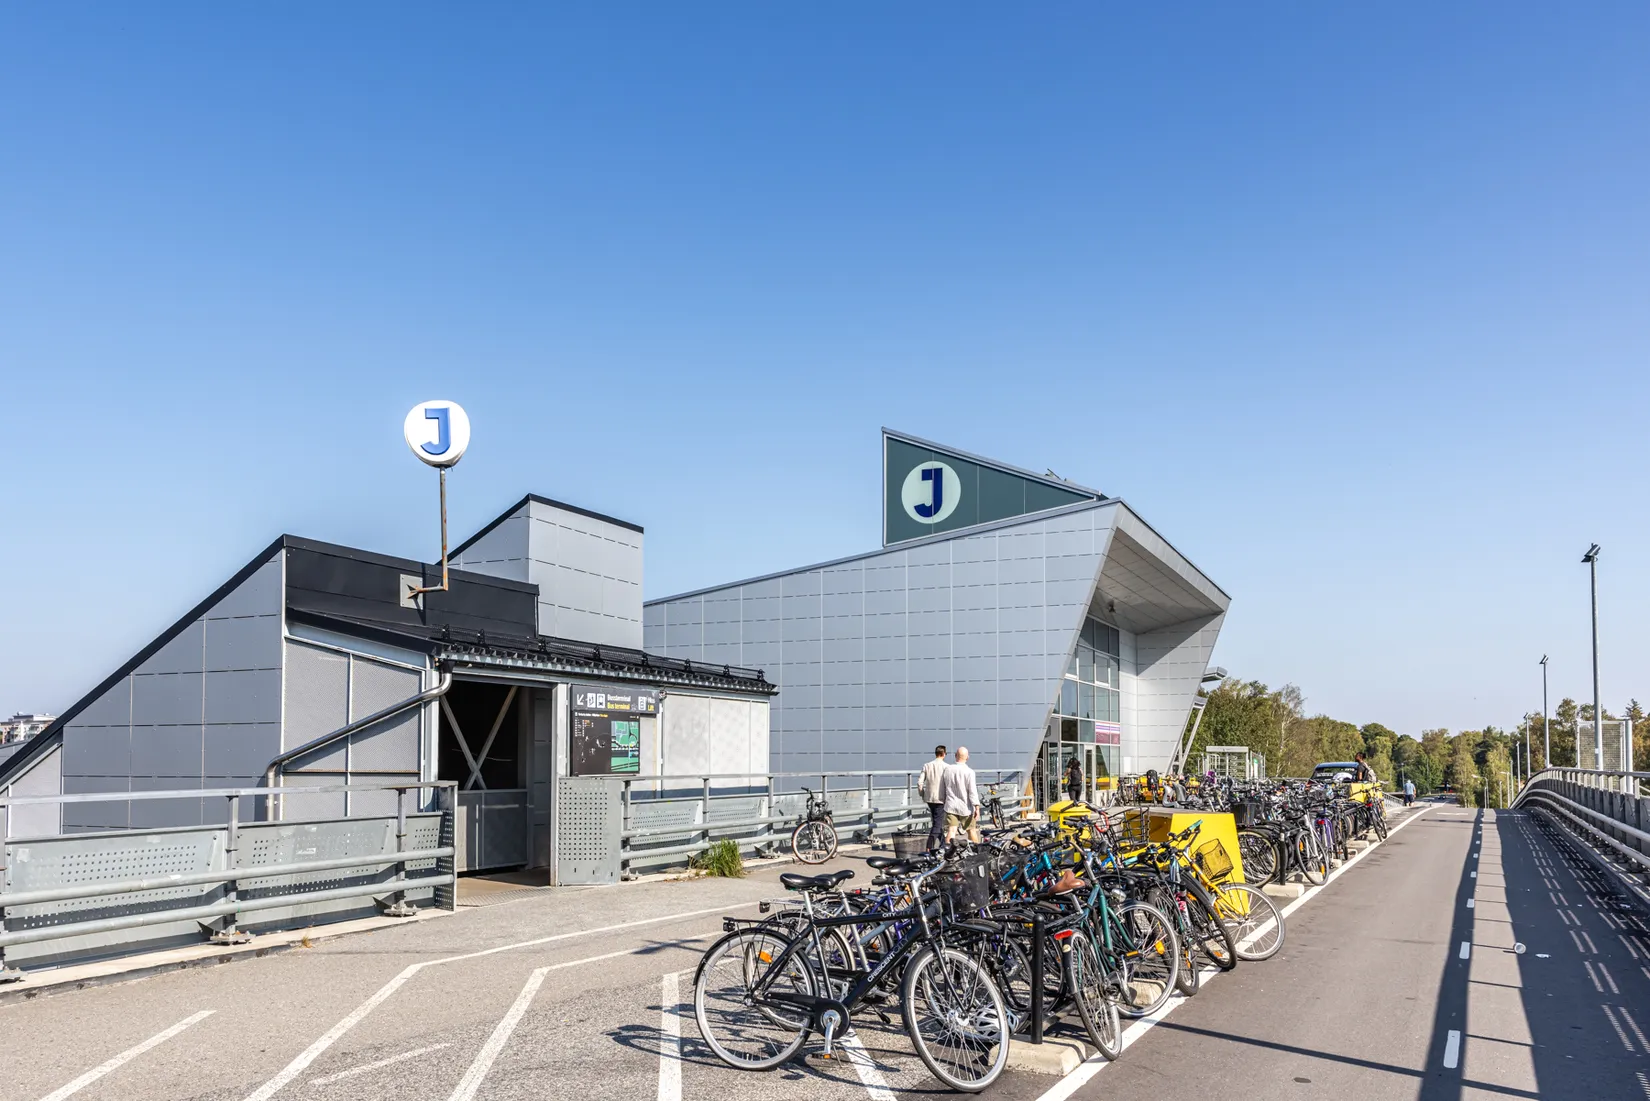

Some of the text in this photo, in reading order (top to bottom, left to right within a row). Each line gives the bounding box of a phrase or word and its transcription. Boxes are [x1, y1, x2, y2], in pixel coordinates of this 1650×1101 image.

[420, 407, 451, 455] J
[913, 467, 943, 518] J
[867, 952, 895, 982] CRESCENT
